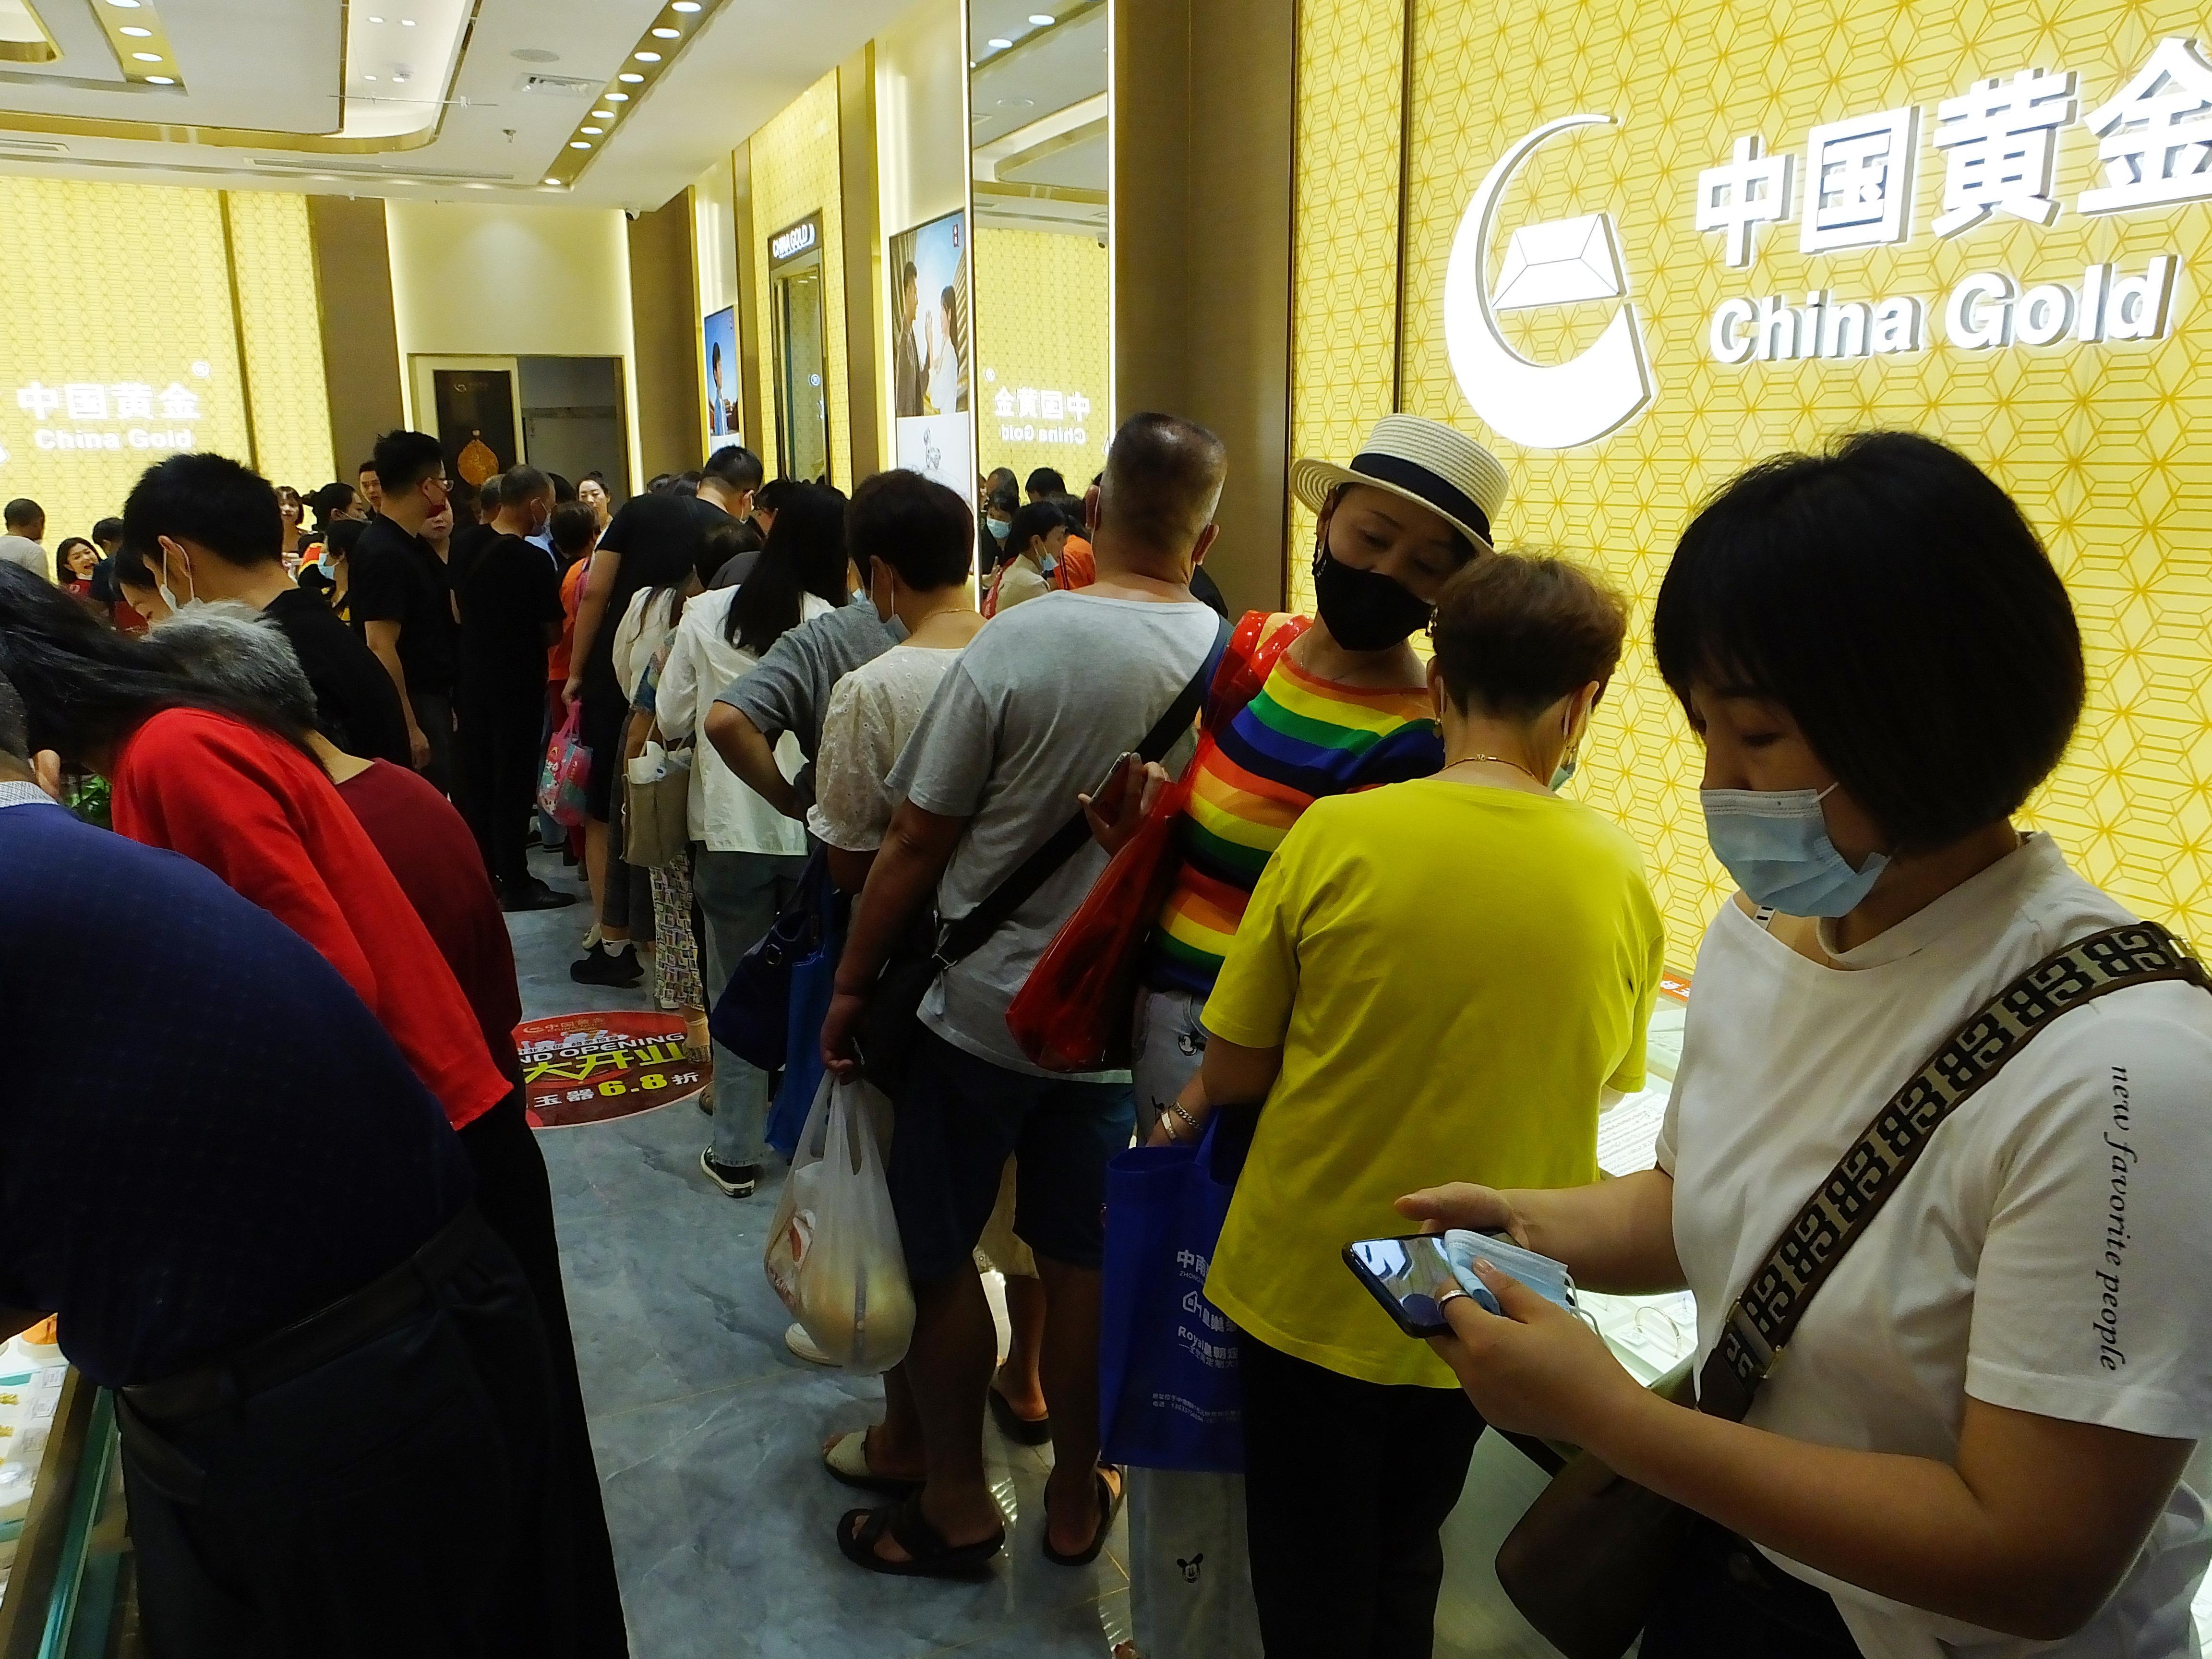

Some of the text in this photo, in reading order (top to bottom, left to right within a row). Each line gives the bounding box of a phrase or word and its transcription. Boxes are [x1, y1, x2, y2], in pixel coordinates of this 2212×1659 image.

[1695, 37, 2212, 268] 中国黄金
[1709, 254, 2181, 364] China Gold
[17, 382, 201, 420] 中国黄金
[34, 428, 192, 449] China Gold
[560, 1032, 685, 1057] OPENING
[598, 1074, 668, 1098] 6.8
[2093, 1065, 2138, 1371] new favorite people
